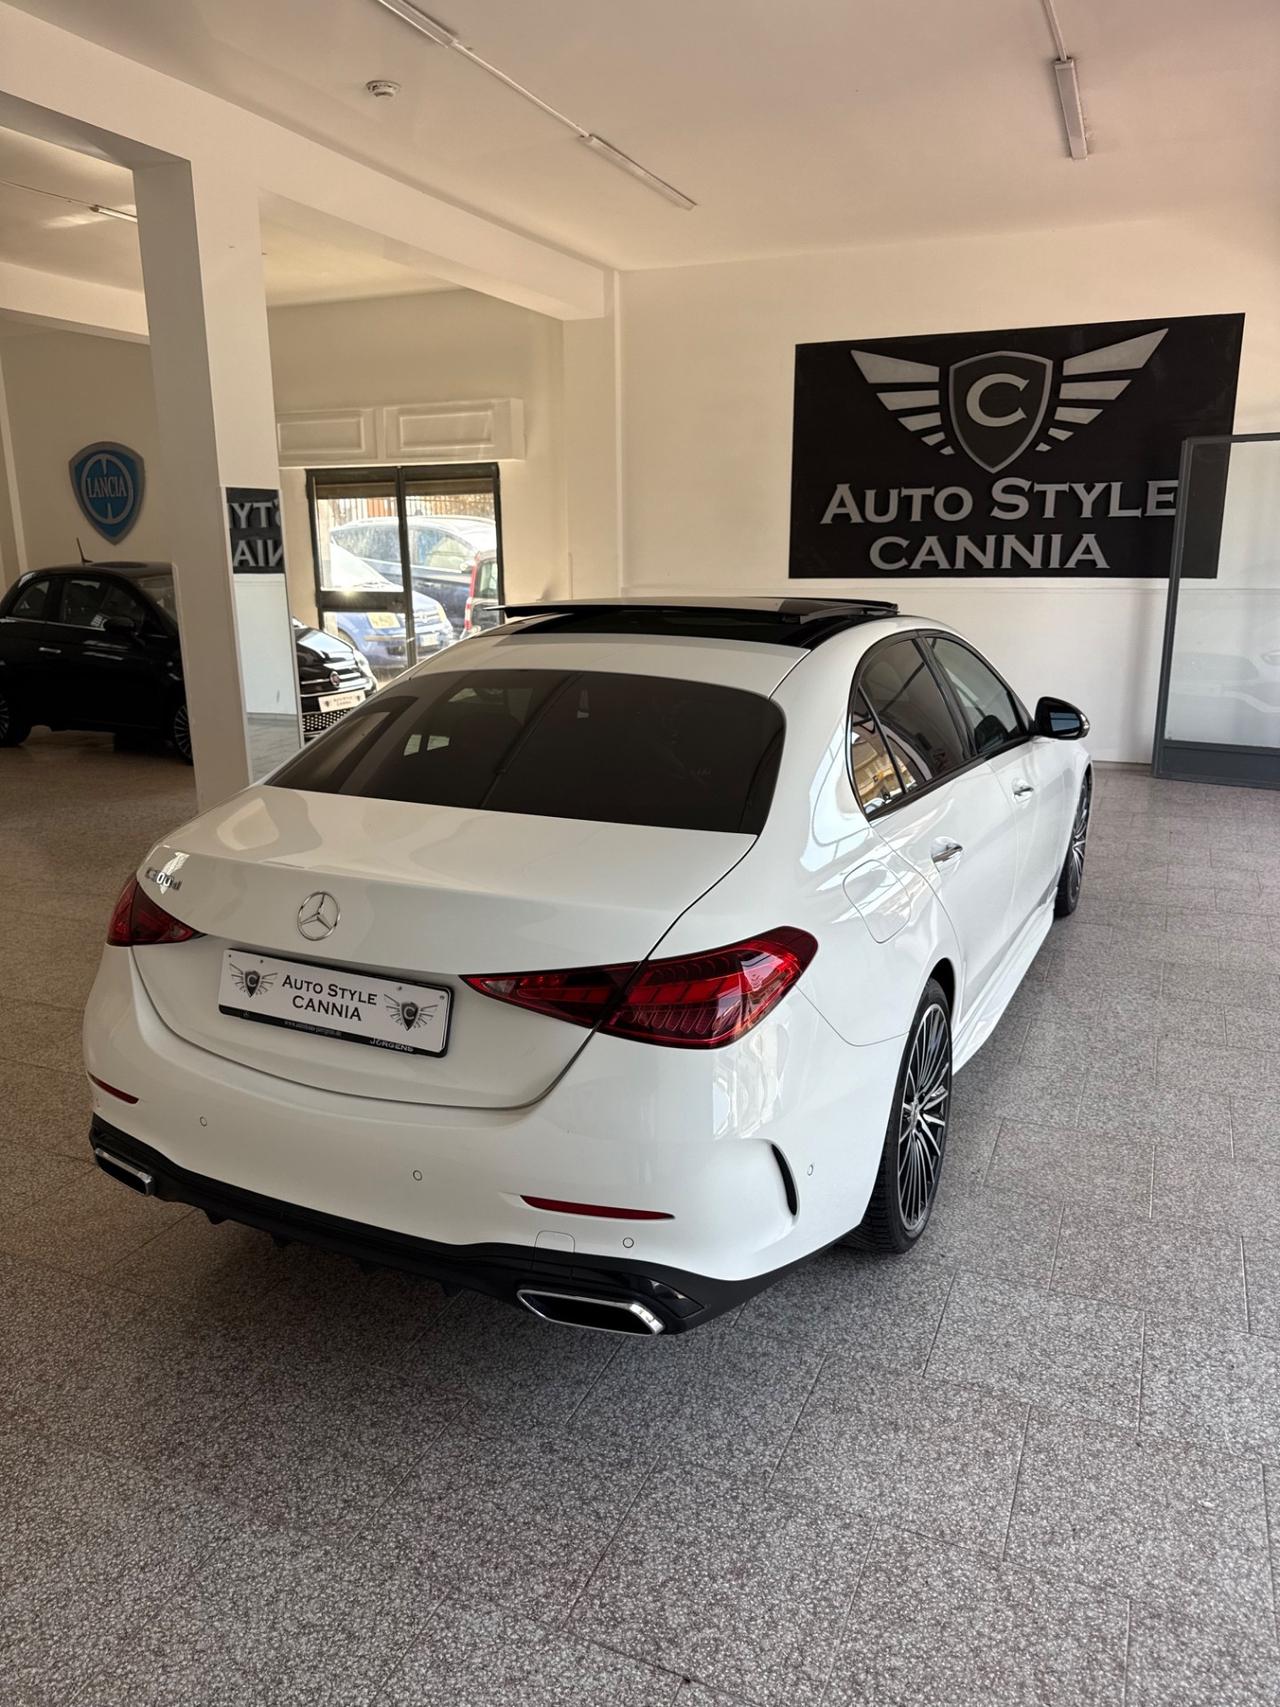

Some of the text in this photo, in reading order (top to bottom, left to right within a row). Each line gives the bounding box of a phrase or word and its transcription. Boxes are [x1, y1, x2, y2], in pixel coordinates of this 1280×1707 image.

[965, 373, 1030, 428] C
[87, 476, 128, 498] LANCIA
[819, 476, 1180, 525] AUTO STYLE
[869, 532, 1111, 571] CANNIA
[281, 974, 378, 1006] AUTO STYLE
[291, 995, 363, 1022] CANNIA
